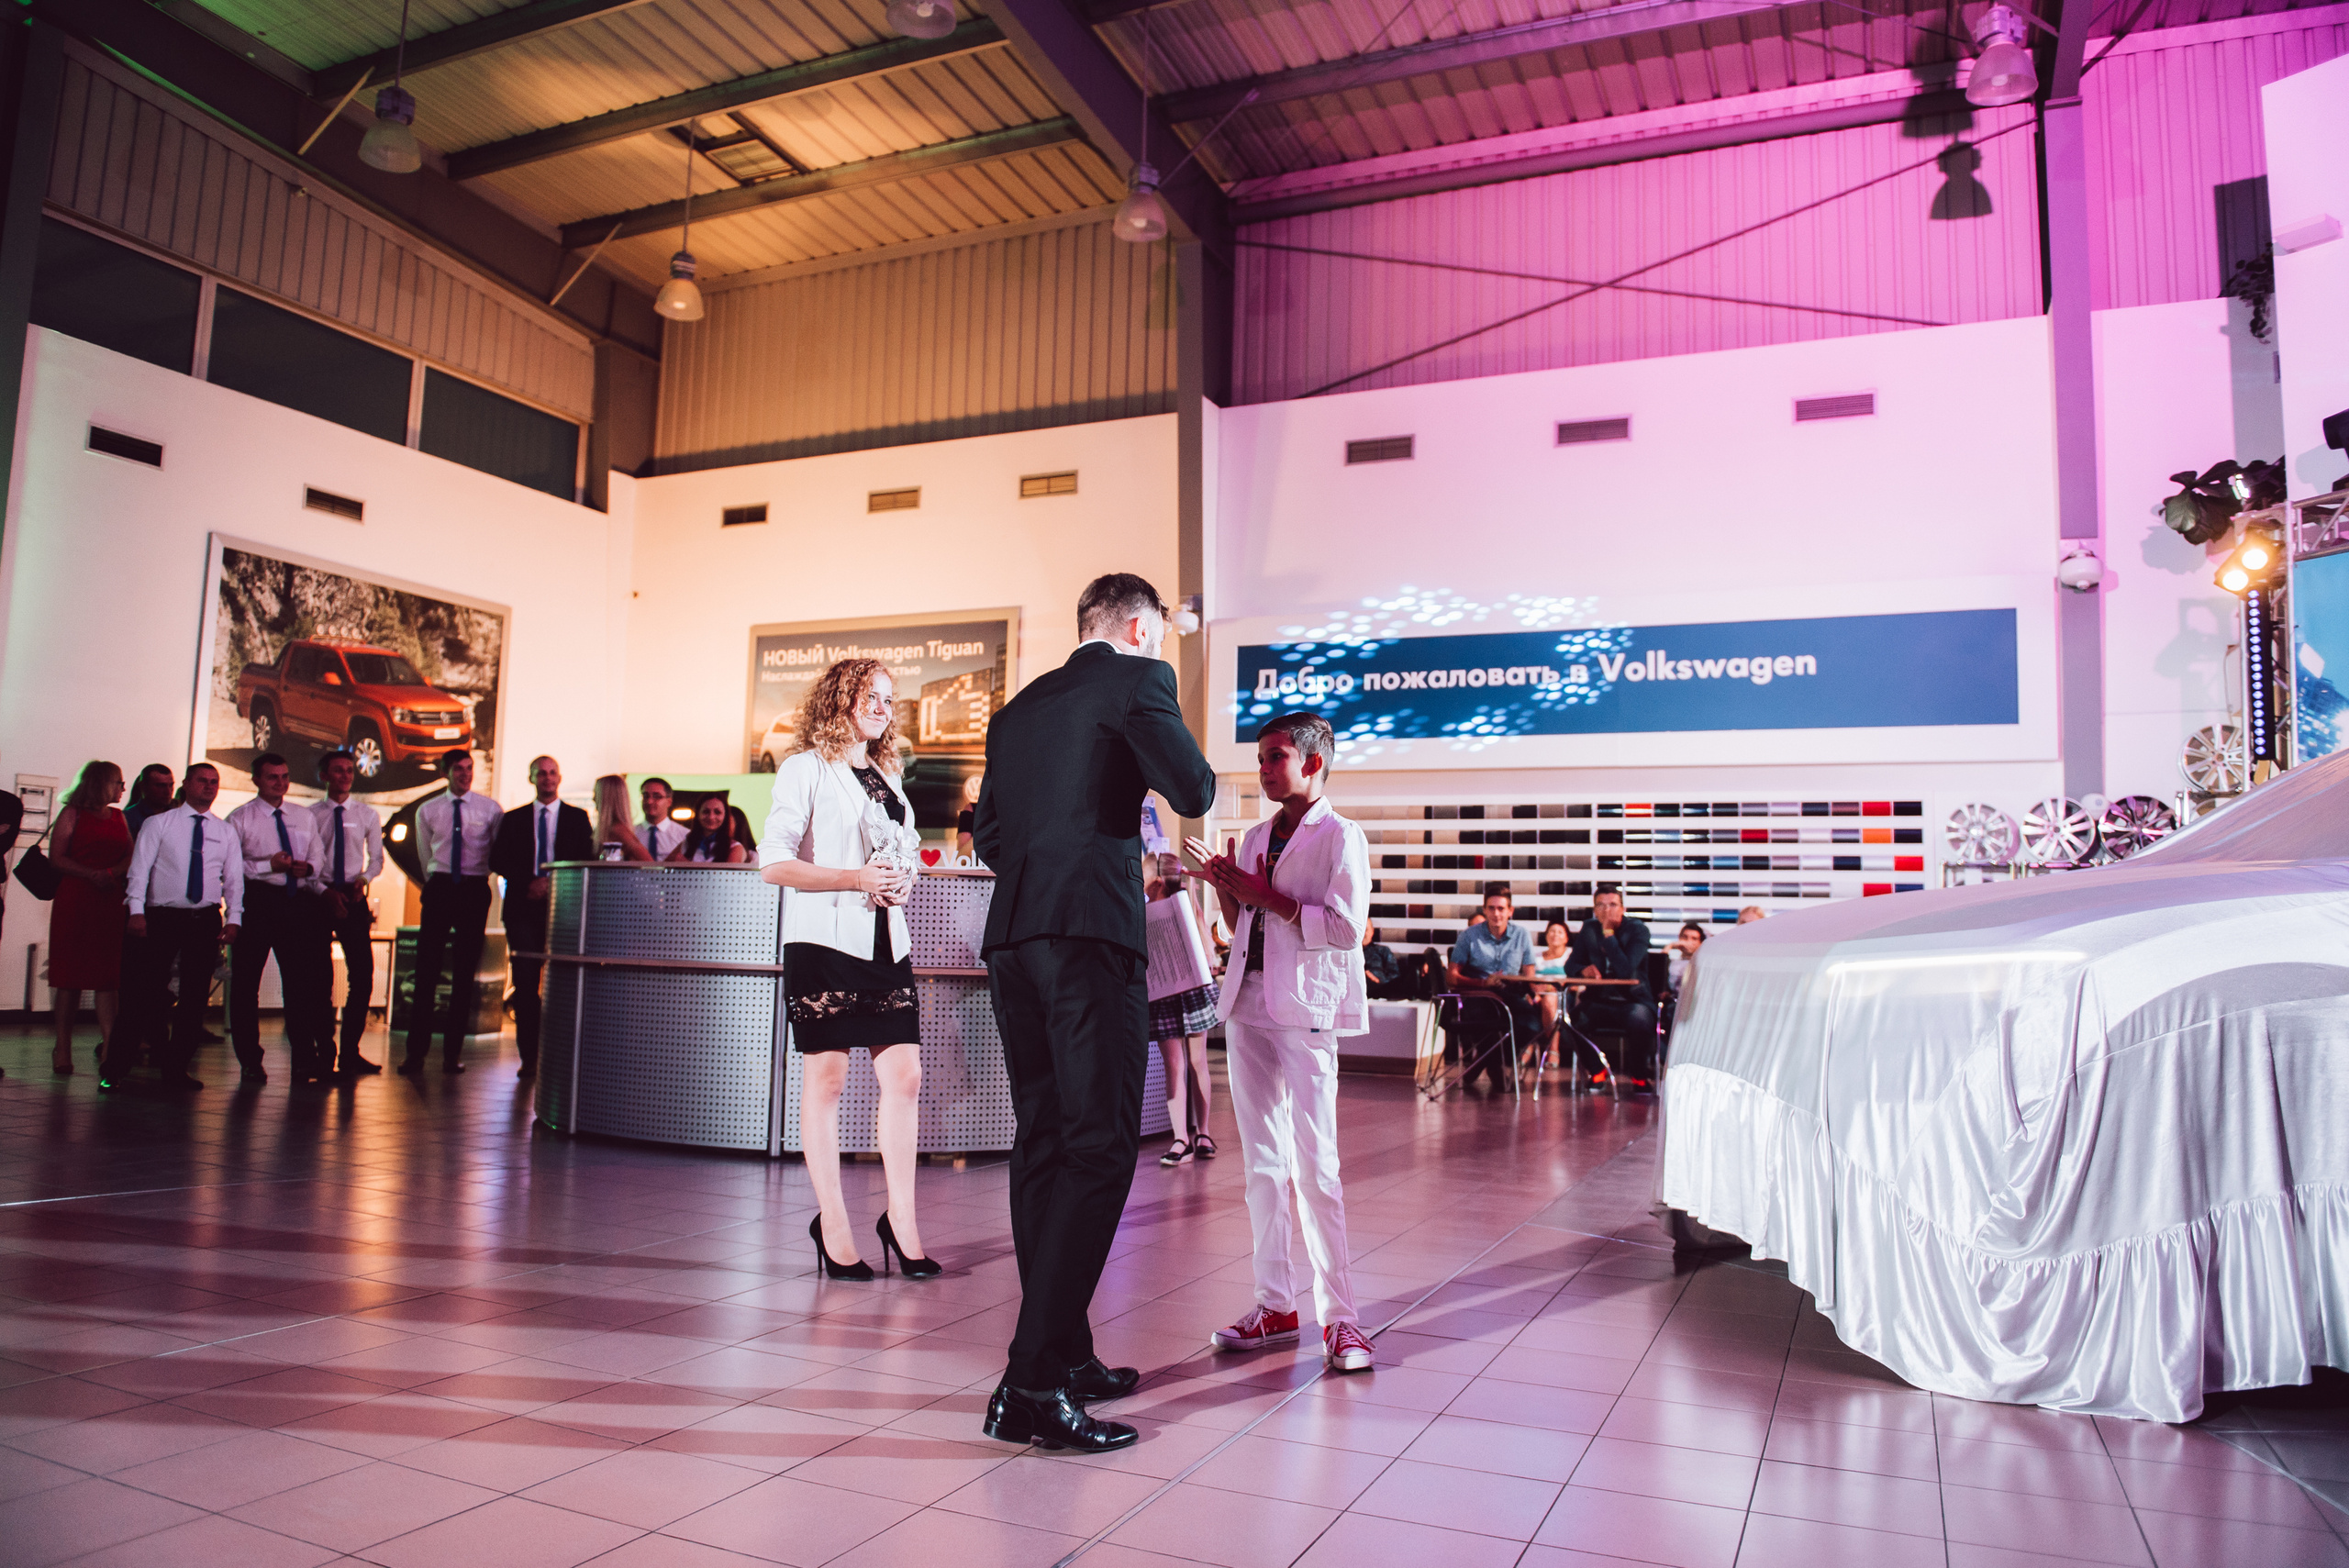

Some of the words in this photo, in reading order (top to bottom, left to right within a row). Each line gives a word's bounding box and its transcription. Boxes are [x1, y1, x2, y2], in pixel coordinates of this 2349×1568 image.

[763, 643, 825, 667] НОВЫЙ
[827, 644, 925, 664] Volkswagen
[926, 639, 985, 662] Tiguan
[1253, 665, 1354, 700] Добро
[1363, 665, 1560, 691] пожаловать
[1570, 664, 1588, 684] в
[1598, 649, 1818, 686] Volkswagen
